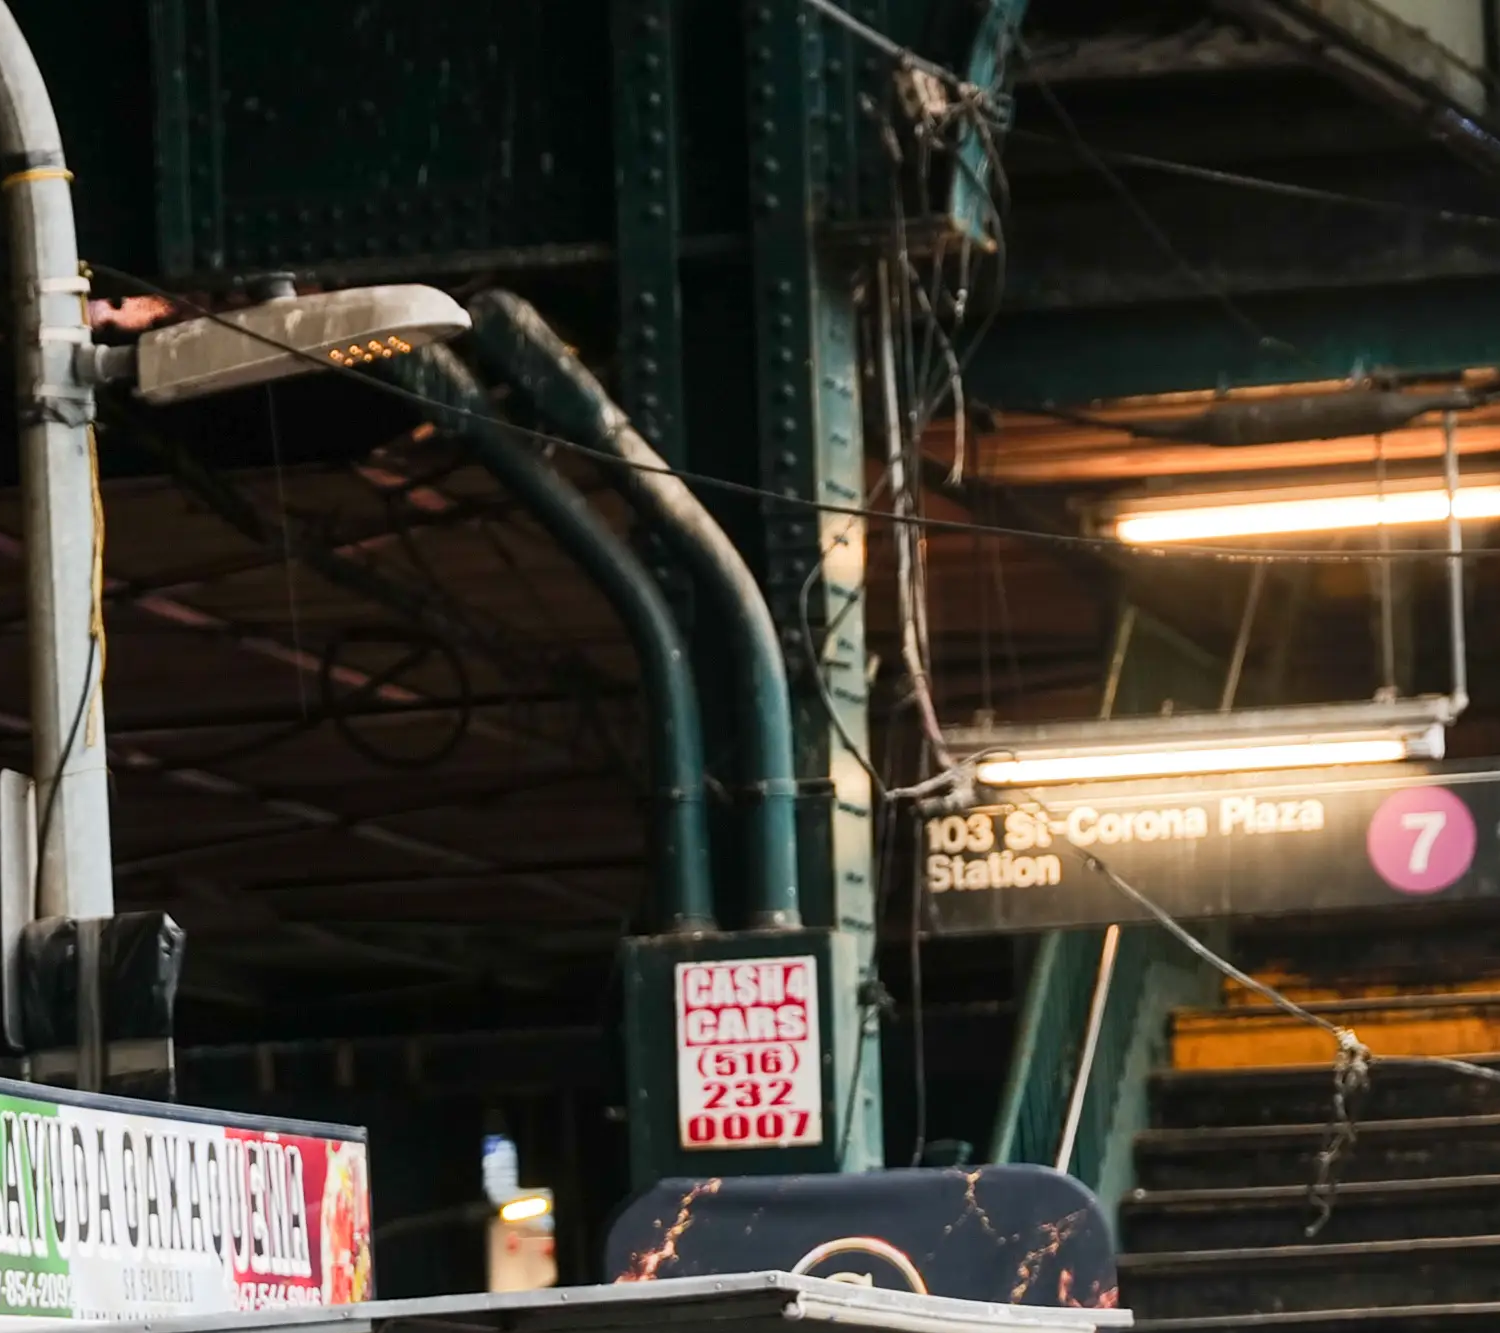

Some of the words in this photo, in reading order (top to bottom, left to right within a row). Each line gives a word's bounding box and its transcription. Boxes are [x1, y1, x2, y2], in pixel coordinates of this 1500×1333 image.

[927, 815, 994, 853] 103
[1219, 796, 1324, 834] Plaza
[1401, 811, 1447, 874] 7
[927, 850, 1061, 893] Station
[685, 965, 786, 1009] CASH
[786, 965, 809, 1001] 4
[687, 1003, 807, 1044] CARS
[697, 1044, 799, 1078] (516)
[703, 1079, 796, 1110] 232
[688, 1111, 810, 1142] 0007
[121, 1130, 313, 1278] OAXAQUEÑA
